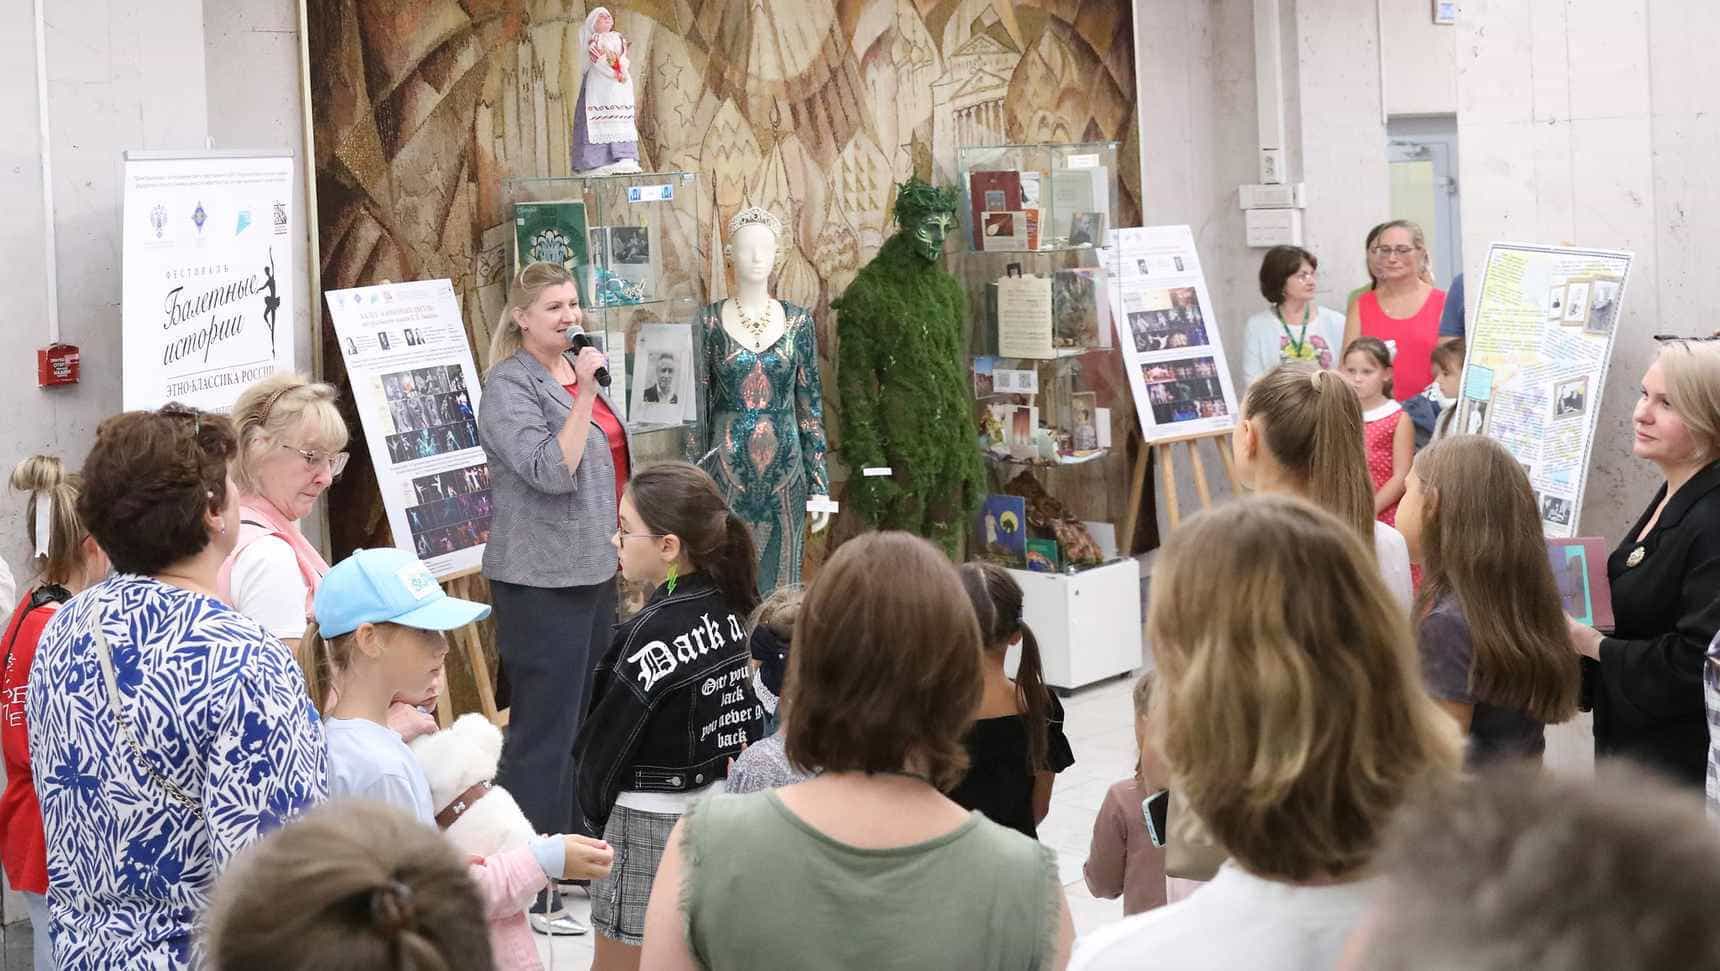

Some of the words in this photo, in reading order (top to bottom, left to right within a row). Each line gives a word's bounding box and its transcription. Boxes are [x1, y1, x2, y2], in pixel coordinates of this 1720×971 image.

[163, 274, 258, 330] Балетные
[163, 314, 244, 366] истории
[166, 371, 240, 398] ЭТНО-КЛАССИКА
[627, 612, 726, 692] Dark
[726, 613, 748, 642] a
[717, 727, 748, 749] back
